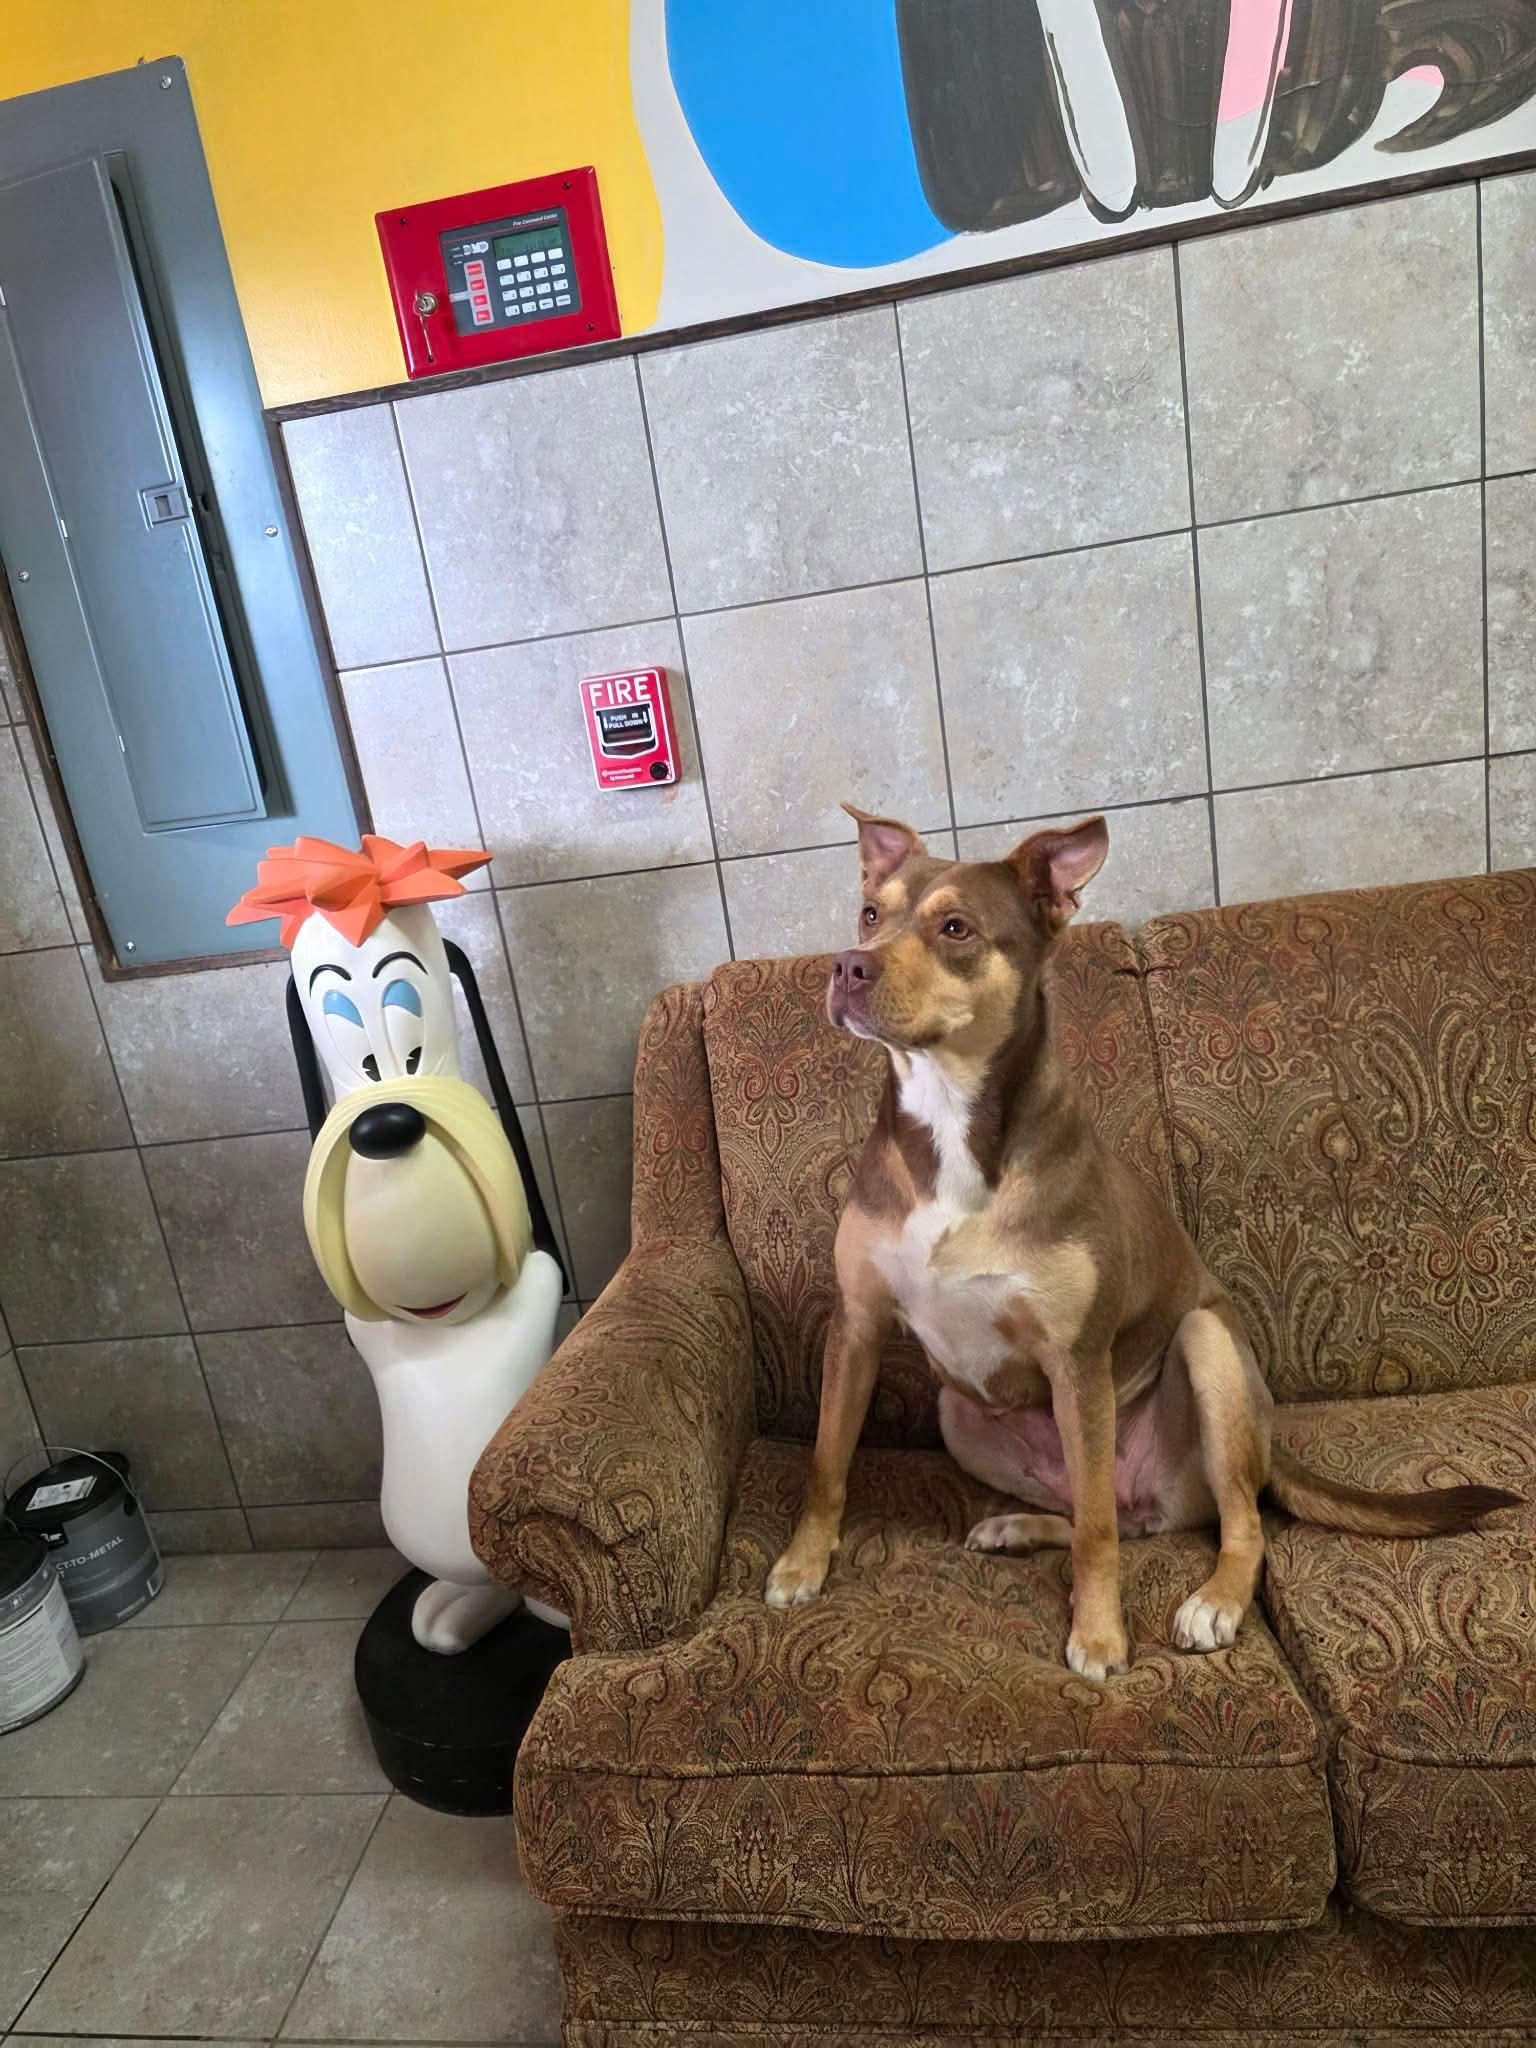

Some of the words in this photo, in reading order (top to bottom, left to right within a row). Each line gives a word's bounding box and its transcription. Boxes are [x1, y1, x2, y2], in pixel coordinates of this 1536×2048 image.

[588, 676, 651, 706] FIRE
[610, 714, 627, 722] PUSH
[624, 719, 644, 728] DOWN
[55, 1535, 125, 1572] CT-TO-METAL
